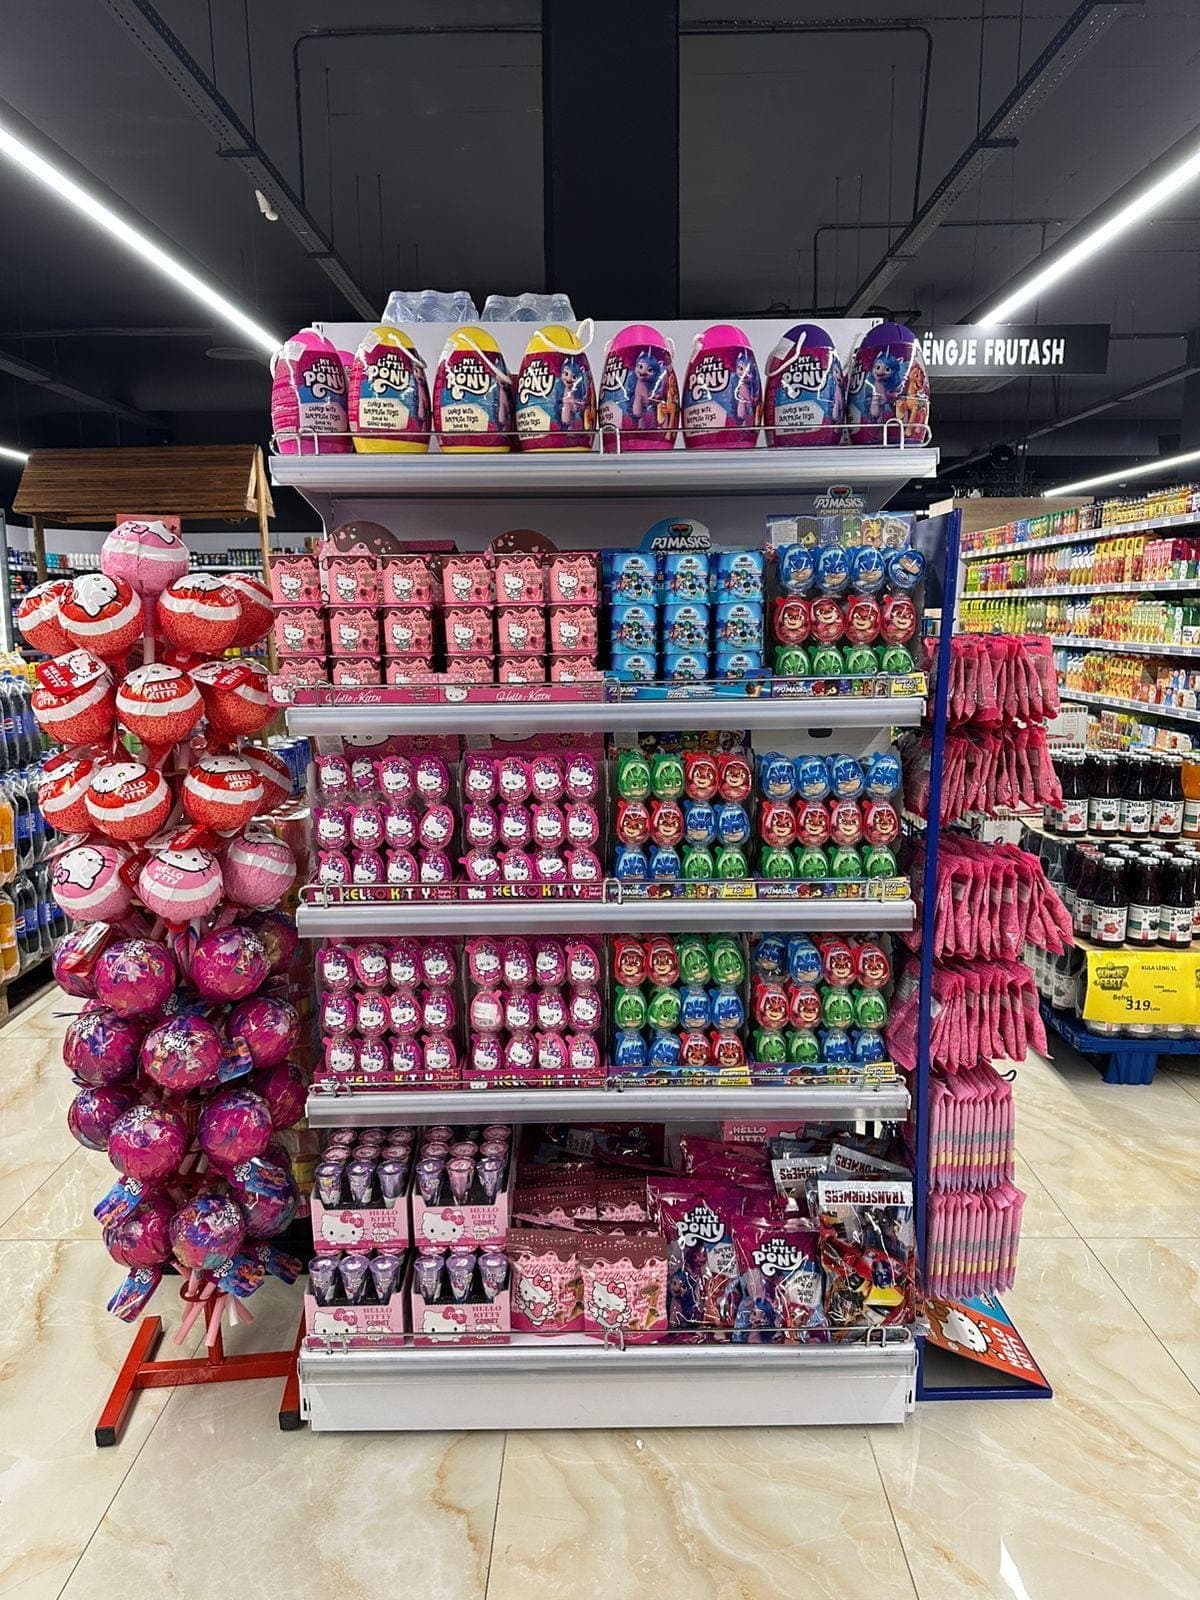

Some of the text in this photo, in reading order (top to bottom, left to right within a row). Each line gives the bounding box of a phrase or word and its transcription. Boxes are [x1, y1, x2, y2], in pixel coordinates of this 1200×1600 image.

[918, 332, 1065, 366] ËNGJE FRUTASH
[703, 356, 714, 364] MY
[790, 362, 821, 371] LITTLE
[303, 370, 345, 398] PONY
[368, 365, 410, 393] PONY
[446, 373, 490, 400] PONY
[689, 370, 729, 400] PONY
[41, 668, 60, 688] KITTY
[47, 664, 68, 687] HELLO
[144, 682, 178, 693] HELLO
[155, 865, 184, 880] HELLO
[1125, 1000, 1151, 1011] 319
[733, 1126, 767, 1134] HELLO
[824, 1190, 906, 1204] TRANSFORMERS
[683, 1211, 719, 1223] LITTLE
[695, 1207, 708, 1215] MY
[676, 1221, 725, 1246] PONY
[771, 1238, 785, 1246] MY
[761, 1244, 796, 1253] LITTLE
[752, 1251, 806, 1276] PONY
[991, 1327, 1024, 1369] HELLO
[1005, 1333, 1036, 1371] KITTY
